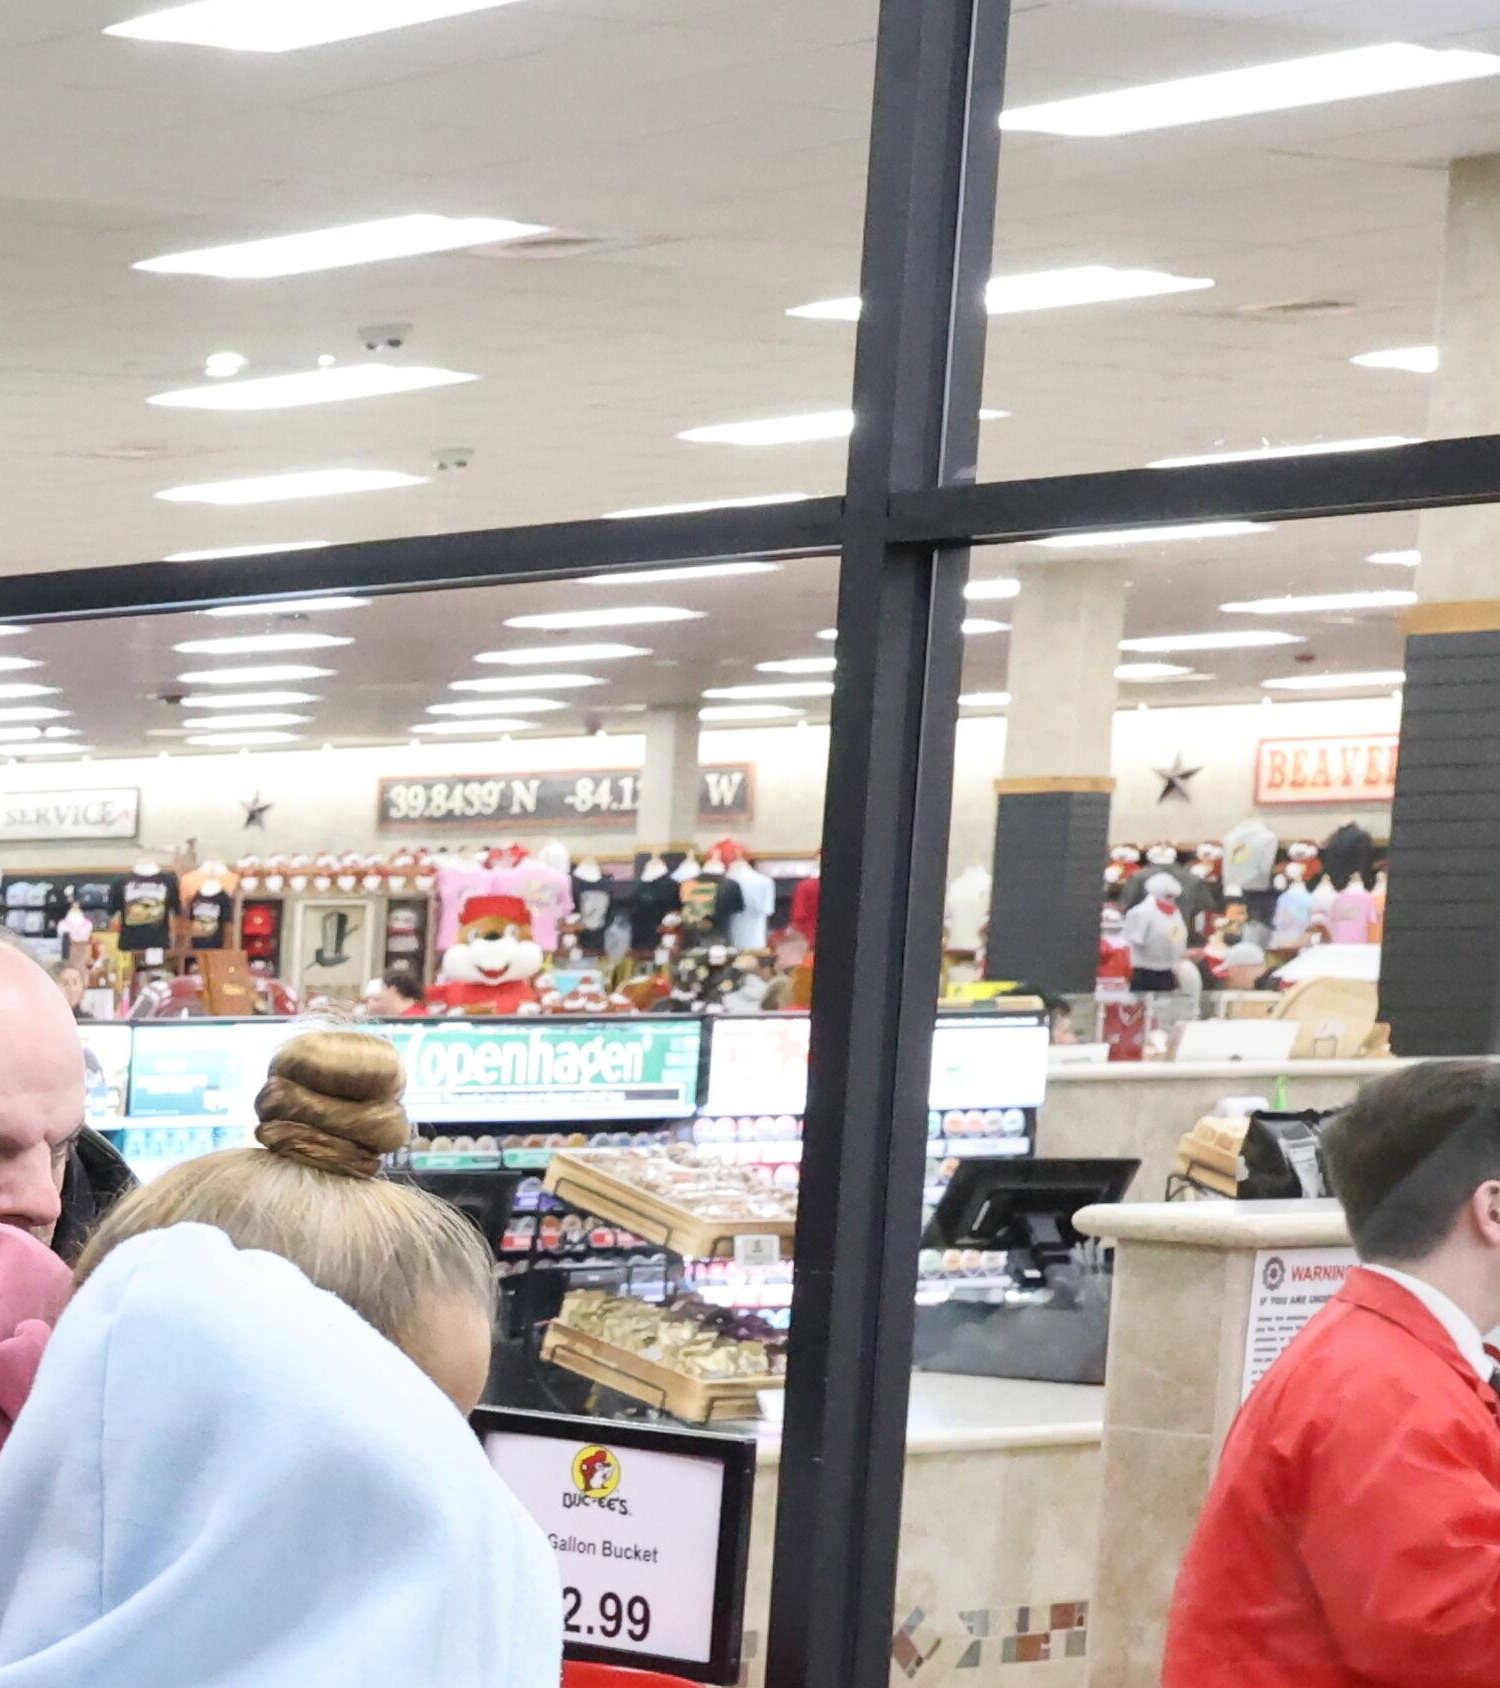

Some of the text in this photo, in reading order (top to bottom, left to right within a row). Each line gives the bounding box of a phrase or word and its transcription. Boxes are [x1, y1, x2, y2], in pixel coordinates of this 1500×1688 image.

[510, 779, 542, 815] N
[563, 776, 640, 812] -84.1
[704, 772, 744, 808] W
[5, 801, 117, 827] SERVICE
[548, 1532, 659, 1563] Gallon Bucket
[562, 1586, 651, 1642] 2.99
